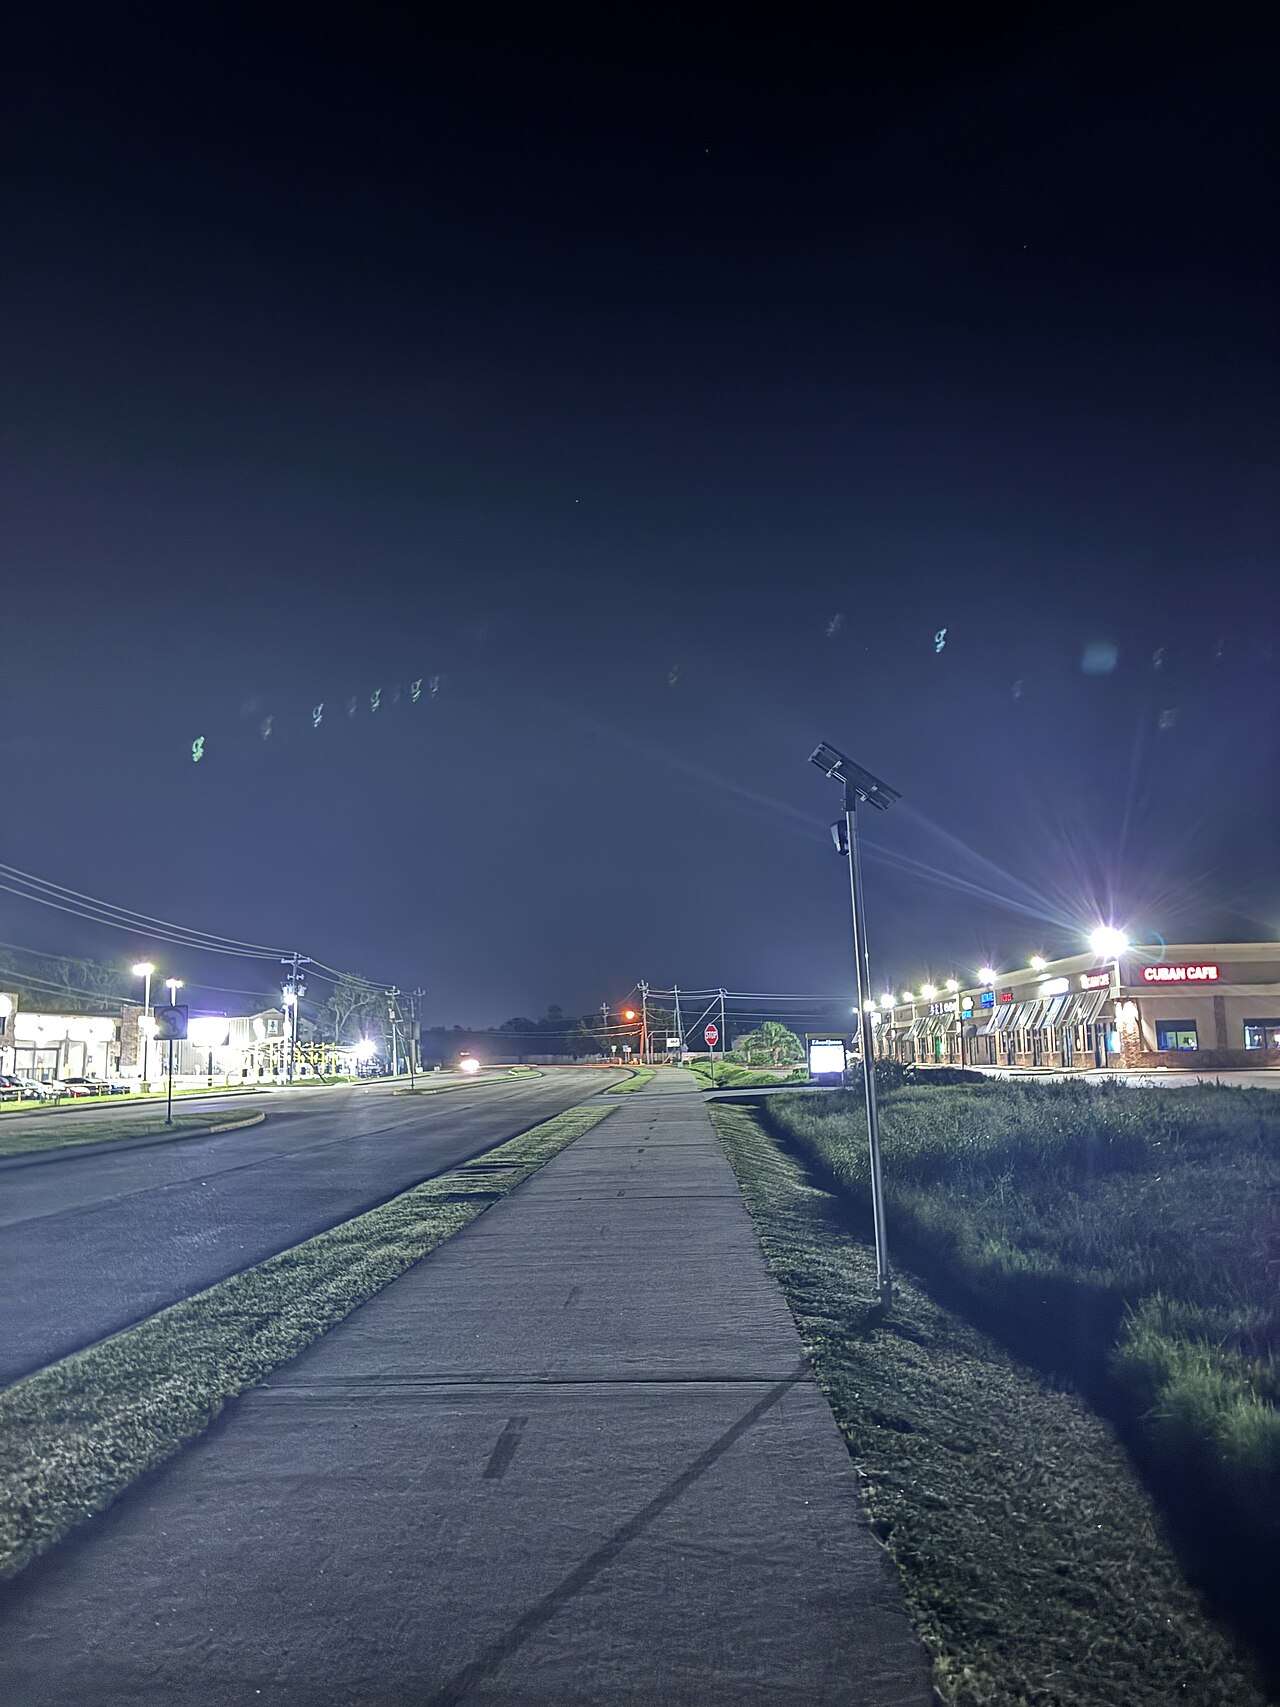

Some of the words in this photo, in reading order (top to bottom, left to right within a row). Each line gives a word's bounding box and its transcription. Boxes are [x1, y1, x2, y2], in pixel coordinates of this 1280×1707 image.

[1144, 967, 1186, 981] CUBAN
[1186, 966, 1218, 980] CAFE
[704, 1031, 718, 1039] STOP
